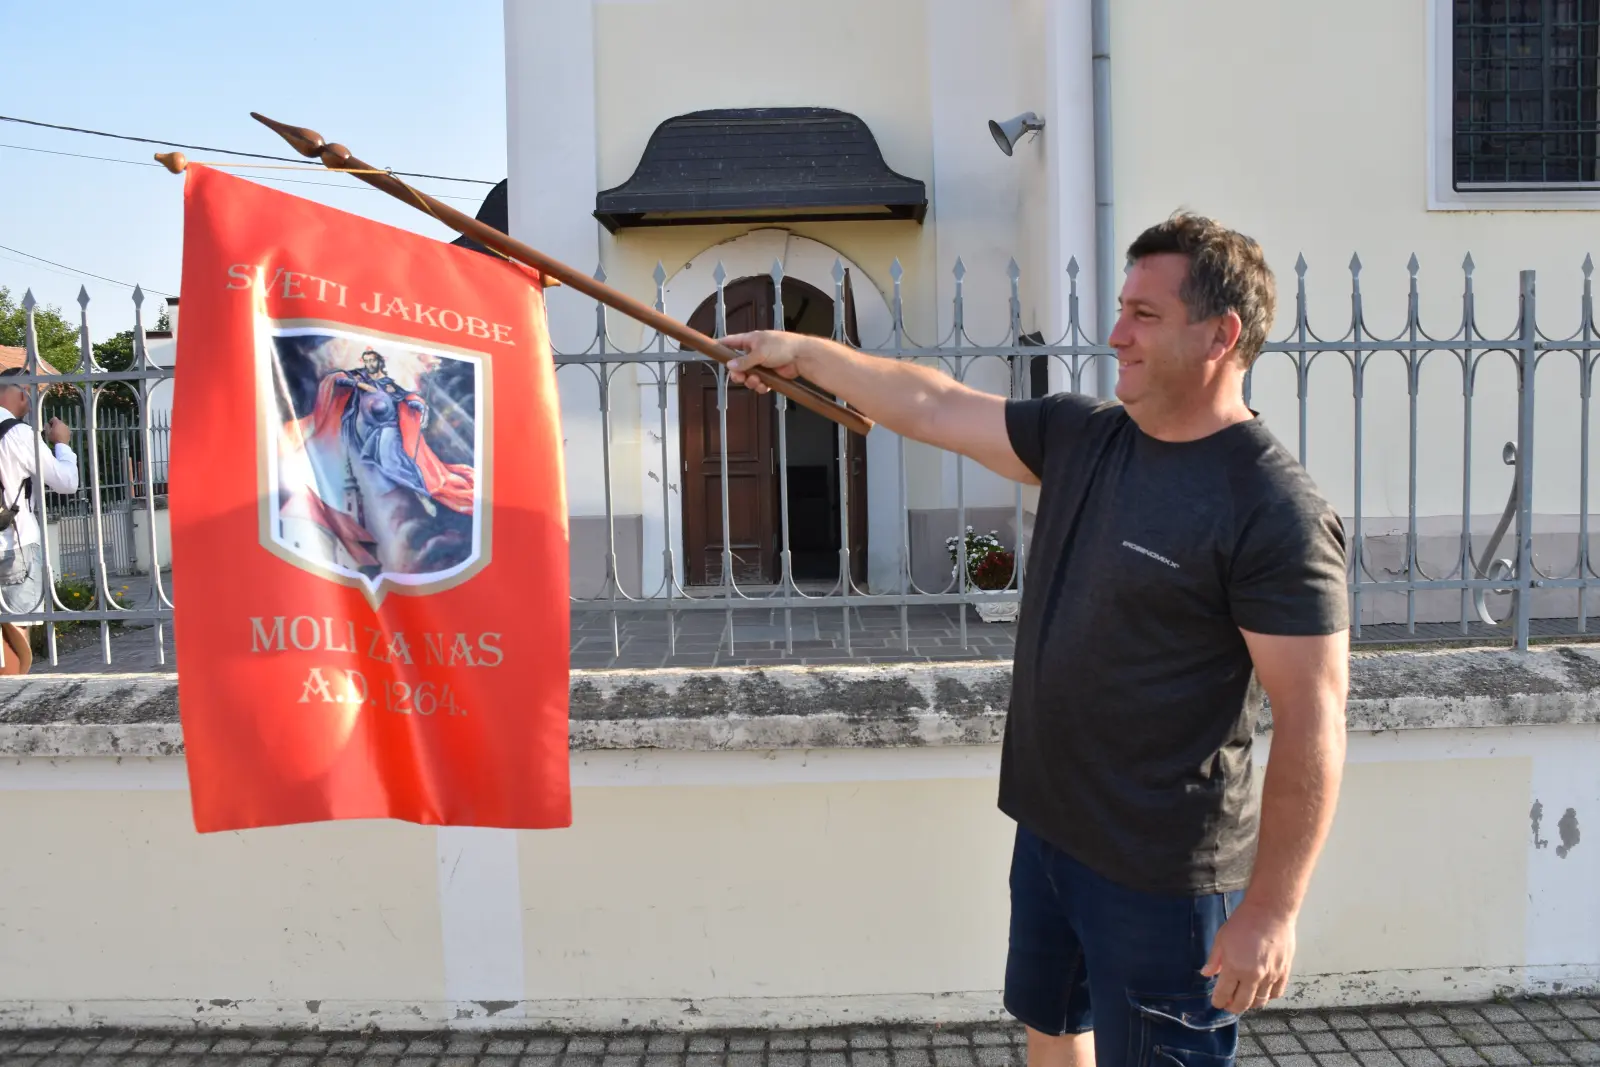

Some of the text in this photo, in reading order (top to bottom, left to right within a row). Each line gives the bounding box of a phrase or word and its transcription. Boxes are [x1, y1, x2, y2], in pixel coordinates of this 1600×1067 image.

[226, 264, 515, 345] SVETI JAKOBE
[250, 616, 504, 667] MOLI ZA NAS
[297, 667, 468, 716] A.D. 1264.
